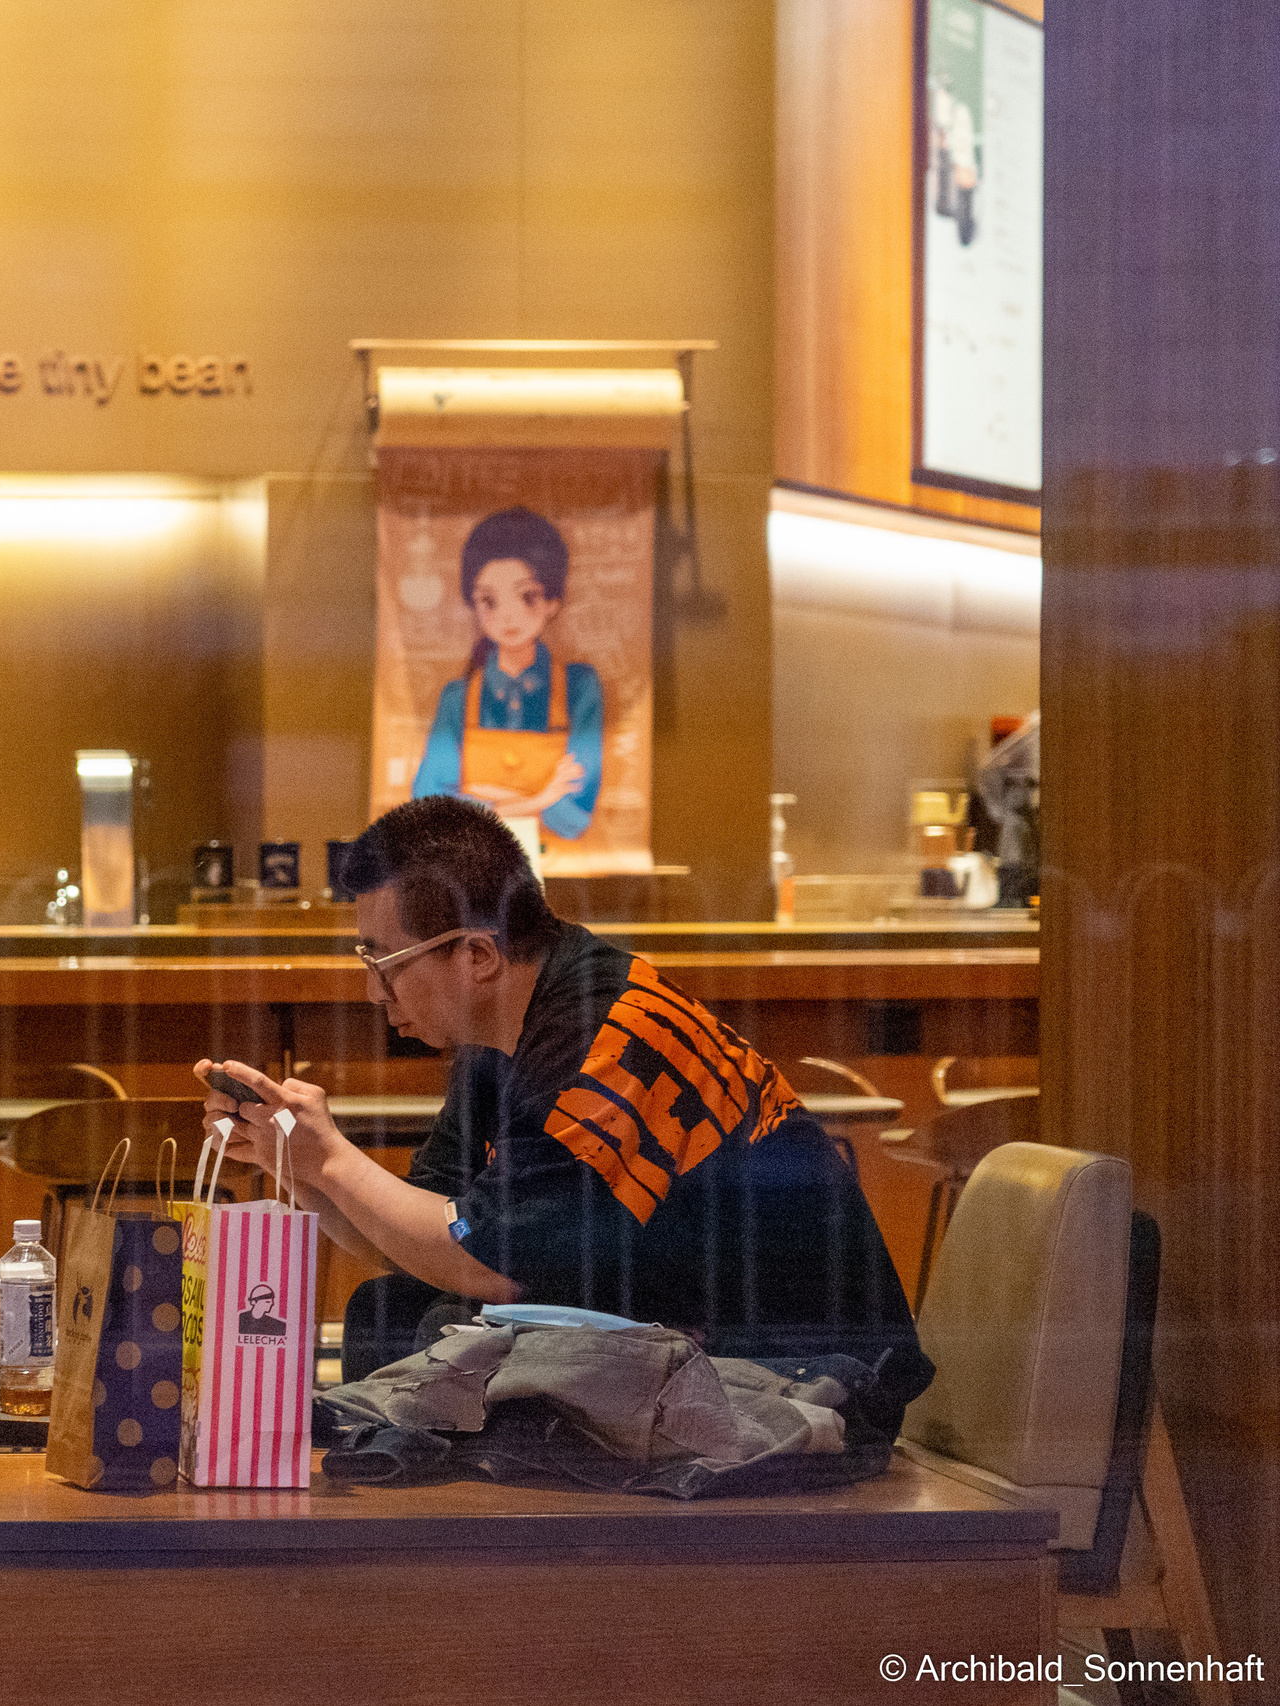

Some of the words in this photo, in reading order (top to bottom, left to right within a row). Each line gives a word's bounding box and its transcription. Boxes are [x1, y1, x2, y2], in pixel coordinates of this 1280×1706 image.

[37, 347, 122, 407] tiny
[137, 346, 253, 399] bean
[237, 1335, 286, 1346] LELECHA
